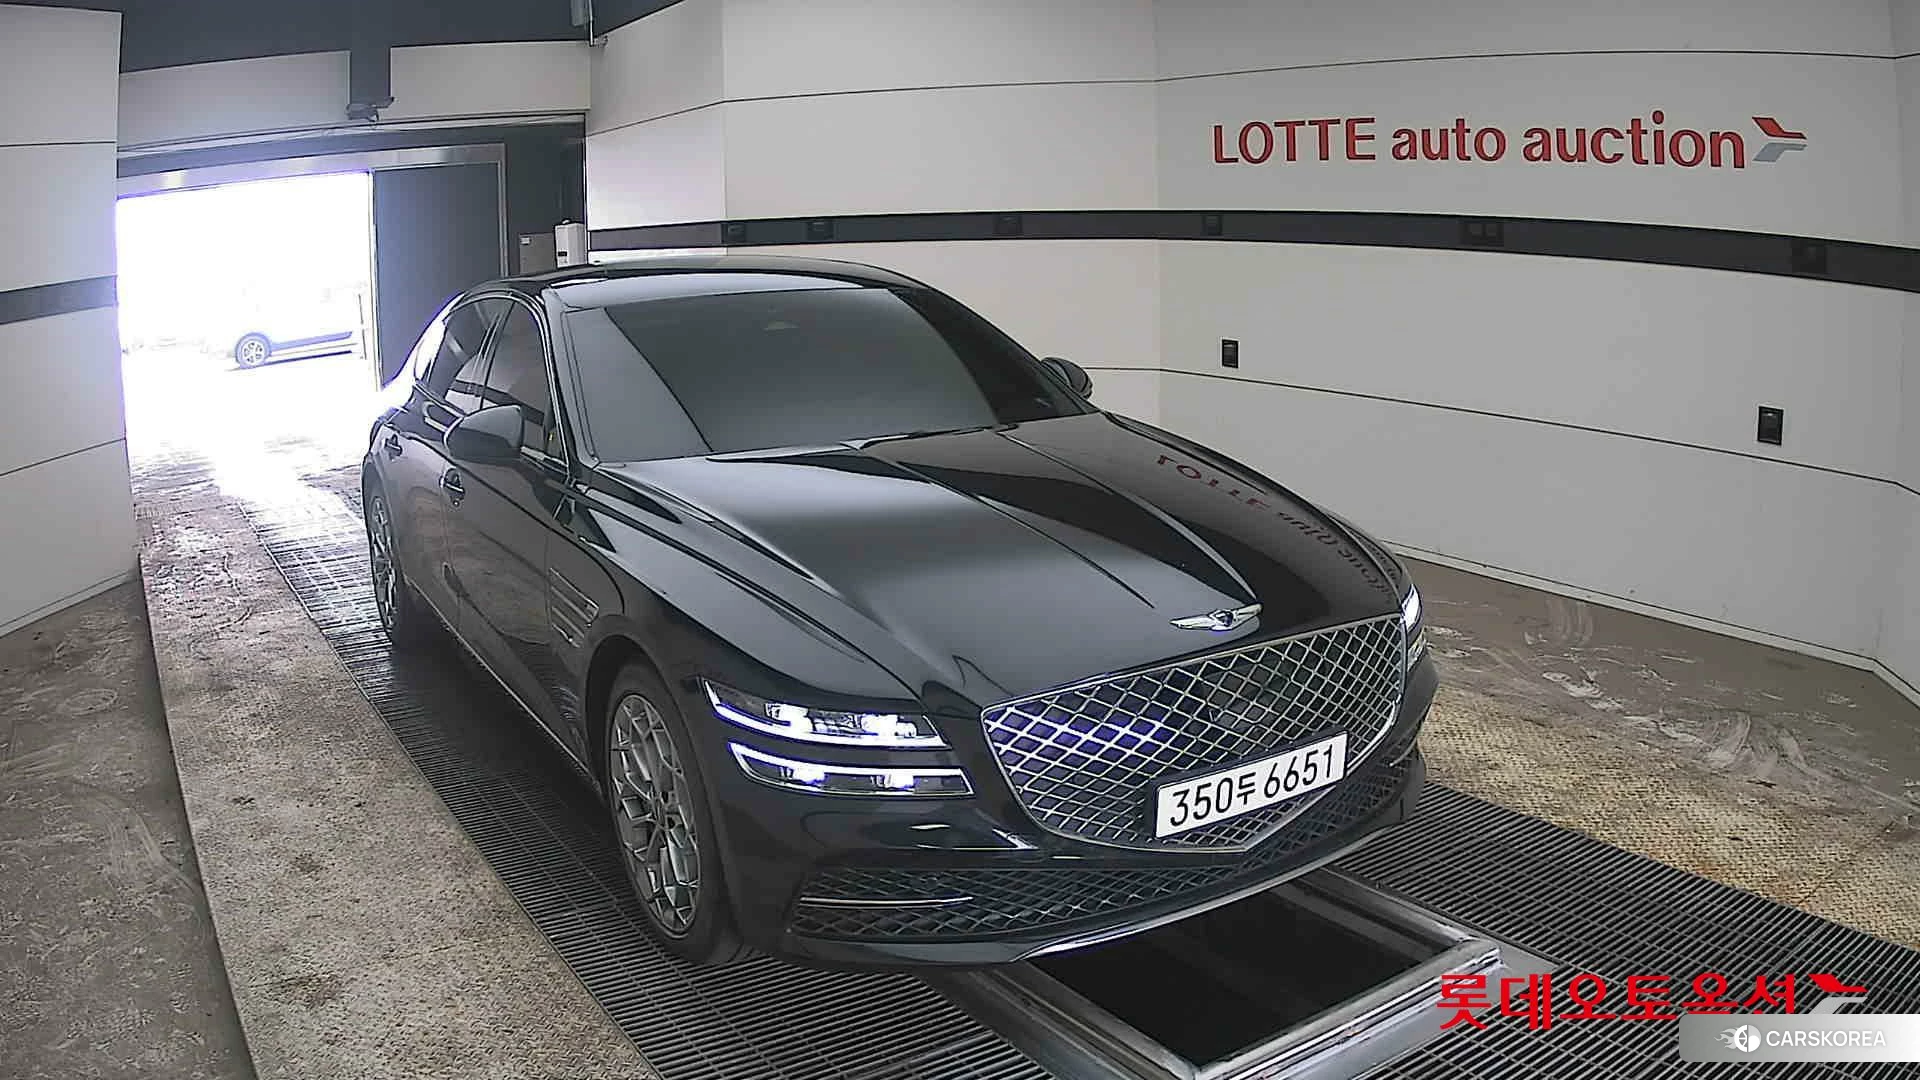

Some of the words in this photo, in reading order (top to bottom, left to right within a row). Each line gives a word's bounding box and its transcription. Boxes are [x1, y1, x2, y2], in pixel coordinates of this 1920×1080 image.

[1212, 116, 1376, 164] LOTTE
[1391, 118, 1507, 161] auto
[1521, 110, 1745, 168] auction
[1170, 773, 1256, 826] 350두
[1264, 745, 1332, 799] 6651
